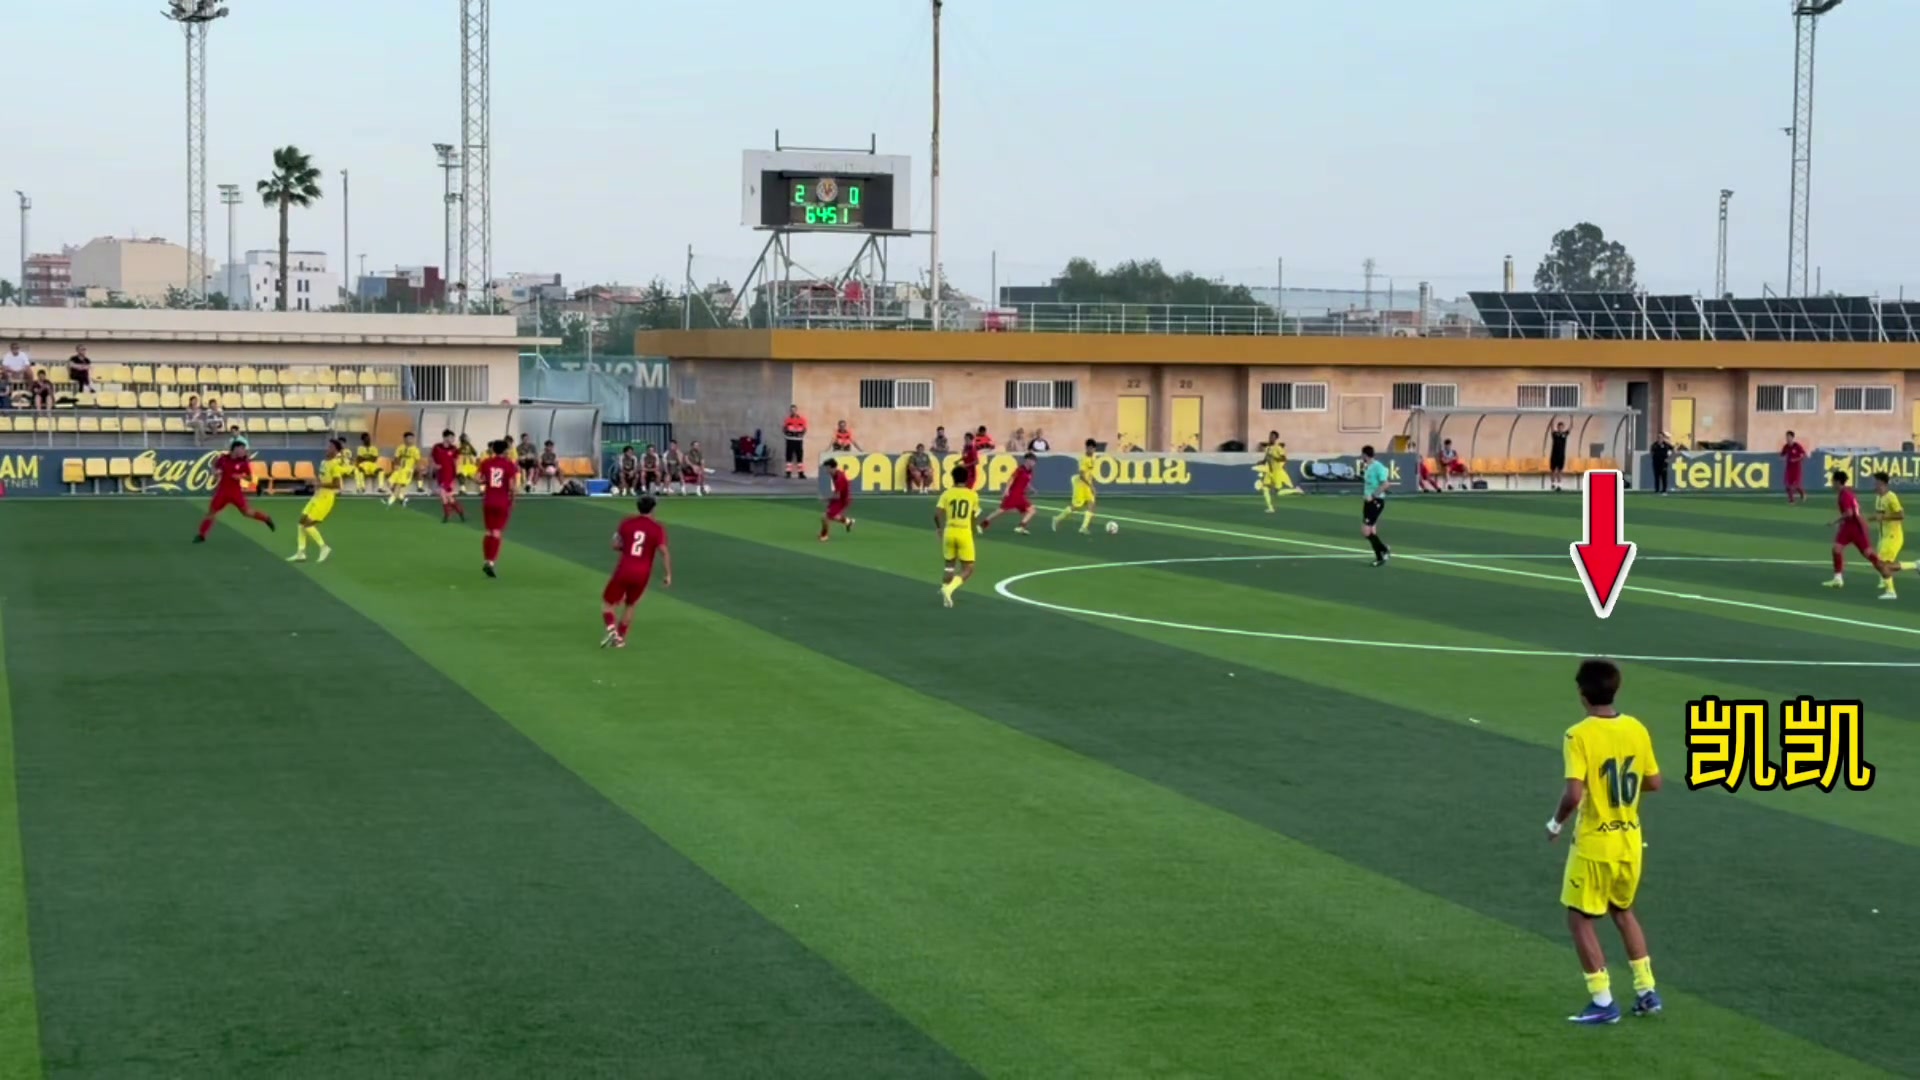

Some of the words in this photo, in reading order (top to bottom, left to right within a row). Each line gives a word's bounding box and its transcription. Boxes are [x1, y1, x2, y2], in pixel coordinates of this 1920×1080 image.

[795, 184, 805, 203] 2
[849, 187, 859, 205] 0
[489, 466, 505, 488] 12
[1091, 455, 1191, 484] oma
[1671, 452, 1770, 488] teika
[948, 499, 969, 519] 10
[631, 531, 645, 556] 2
[1599, 755, 1638, 808] 16
